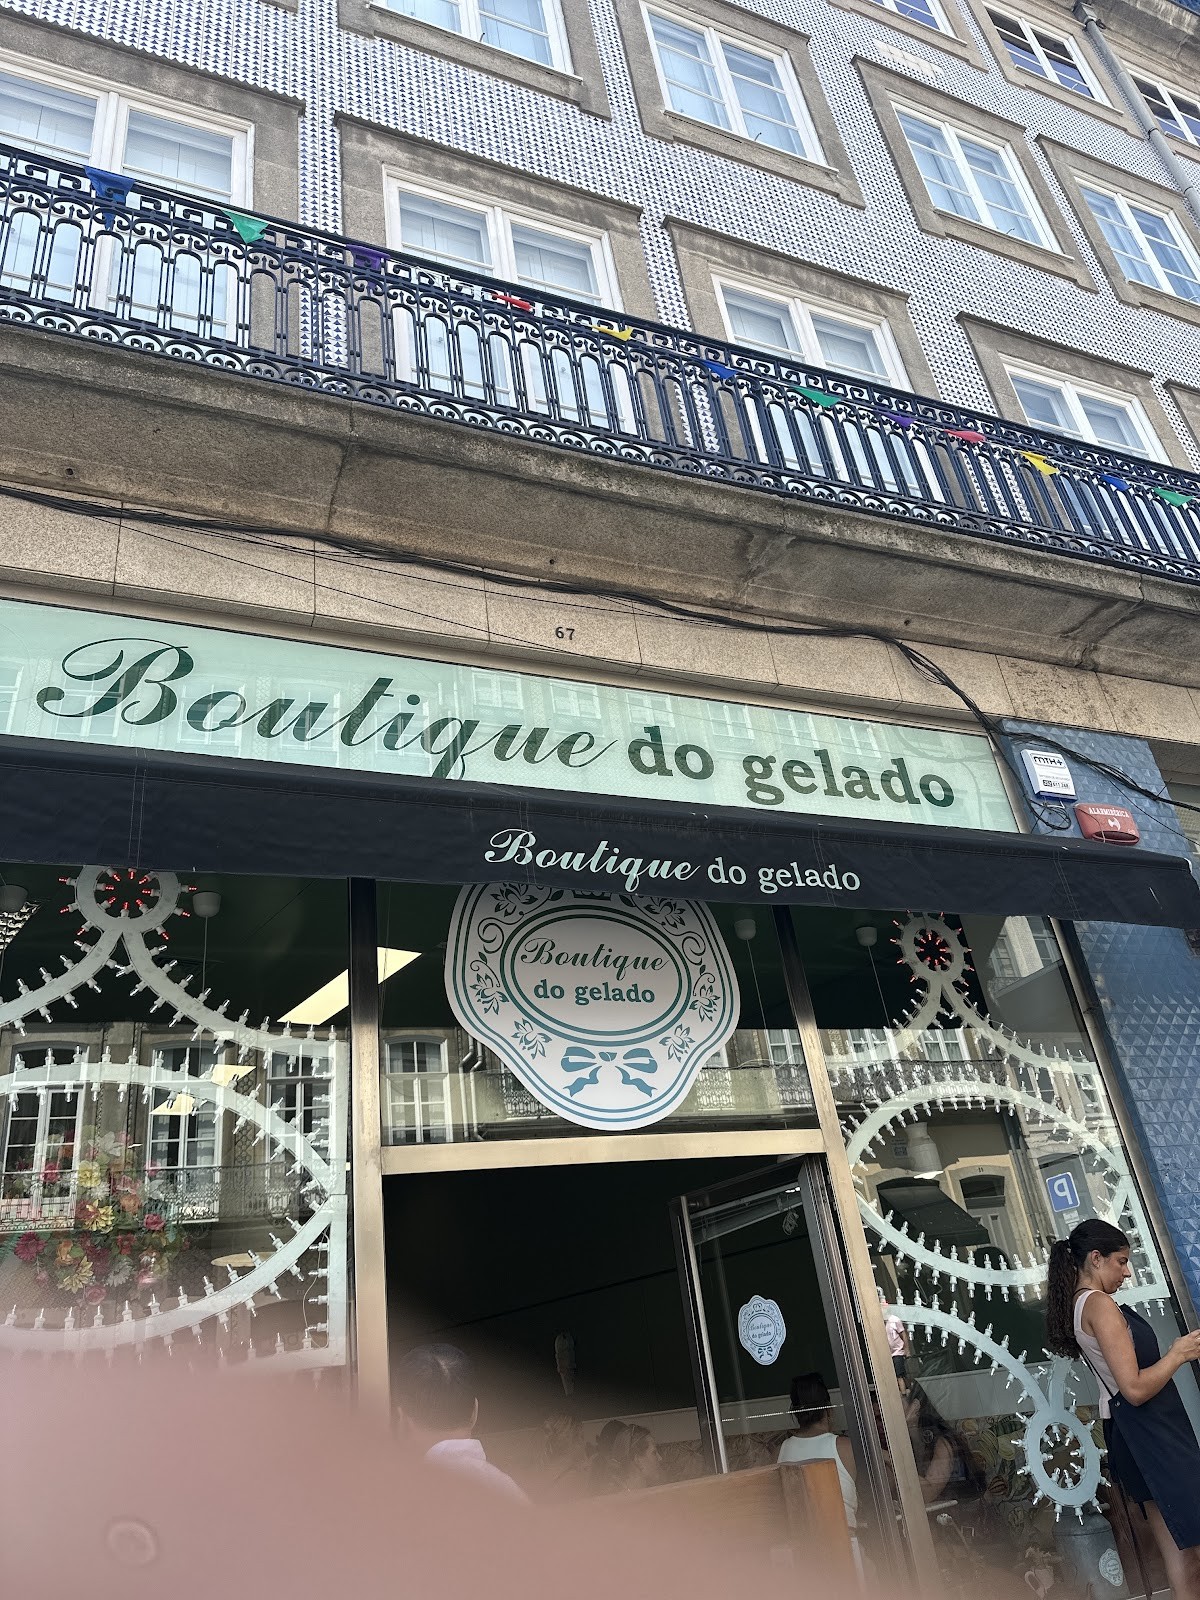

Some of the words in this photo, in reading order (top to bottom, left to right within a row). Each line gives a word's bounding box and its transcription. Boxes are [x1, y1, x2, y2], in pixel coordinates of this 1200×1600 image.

[555, 626, 575, 640] 67
[36, 638, 618, 780] Boutique
[627, 726, 715, 780] do
[742, 749, 955, 808] gelado
[484, 828, 701, 892] Boutique
[707, 857, 747, 884] do
[758, 861, 861, 894] gelado
[520, 937, 670, 981] Boutique
[533, 979, 565, 999] do
[574, 982, 655, 1006] gelado
